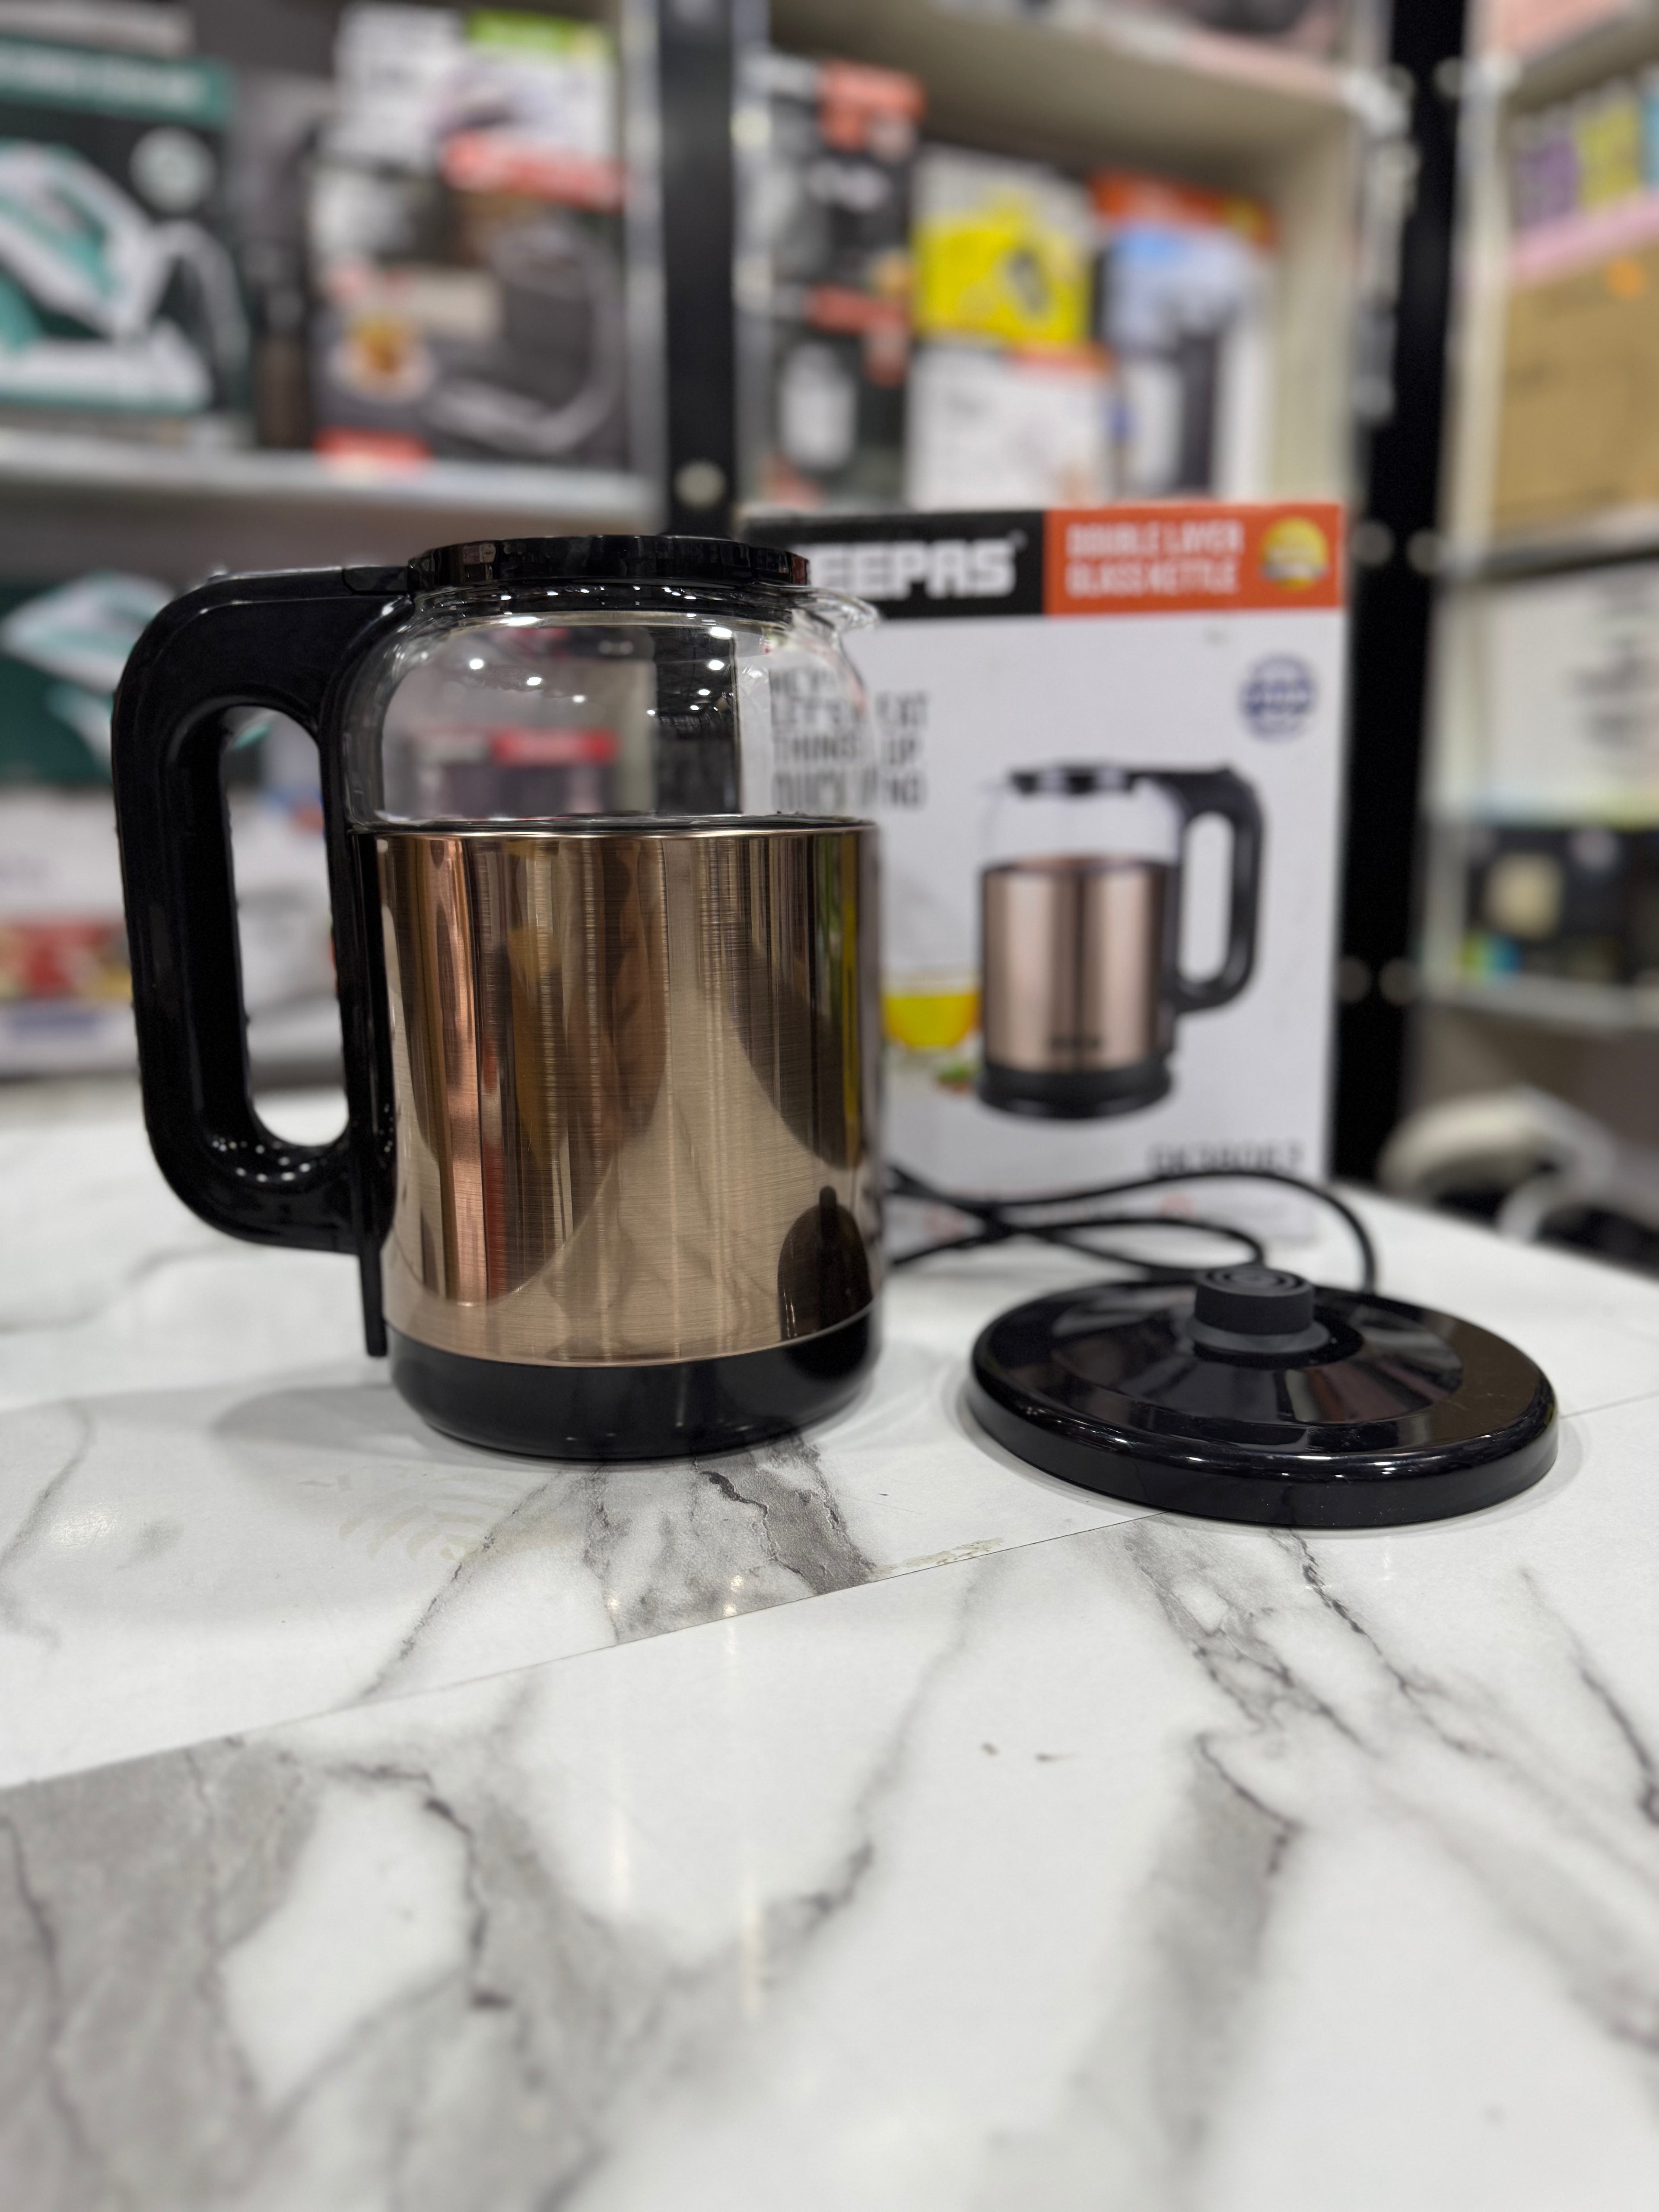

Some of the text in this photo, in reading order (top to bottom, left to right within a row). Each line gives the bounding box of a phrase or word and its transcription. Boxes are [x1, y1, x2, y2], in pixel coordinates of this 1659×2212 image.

[1065, 519, 1244, 558] DOUBLE LAYER
[791, 538, 1015, 600] EEPAS
[1147, 559, 1240, 594] KETTLE
